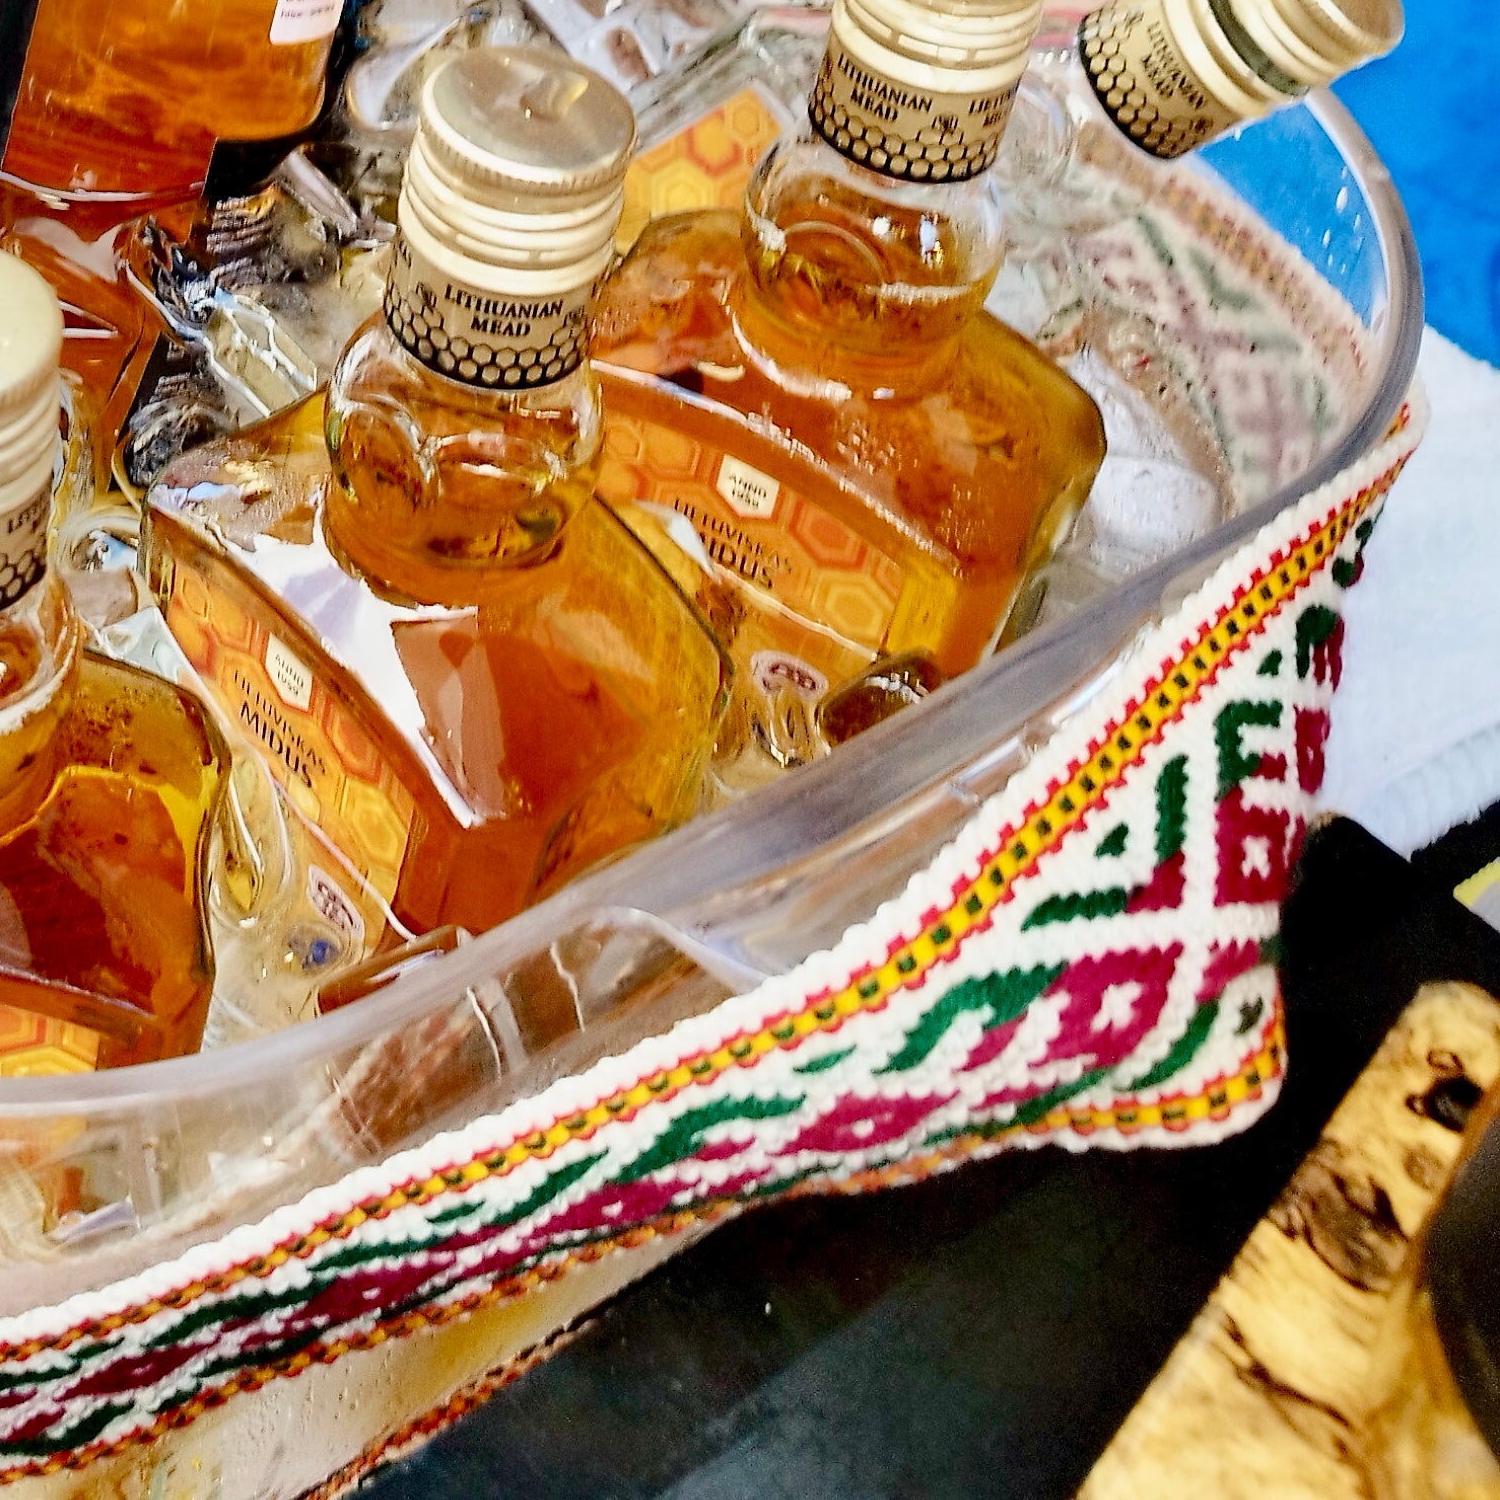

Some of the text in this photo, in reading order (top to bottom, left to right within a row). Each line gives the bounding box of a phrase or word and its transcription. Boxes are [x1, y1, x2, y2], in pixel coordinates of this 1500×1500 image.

[838, 54, 933, 112] LITHUANIAN
[851, 90, 898, 121] MEAD
[445, 285, 563, 319] LITHUANIAN
[471, 316, 530, 336] MEAD
[240, 700, 312, 788] MIDUS
